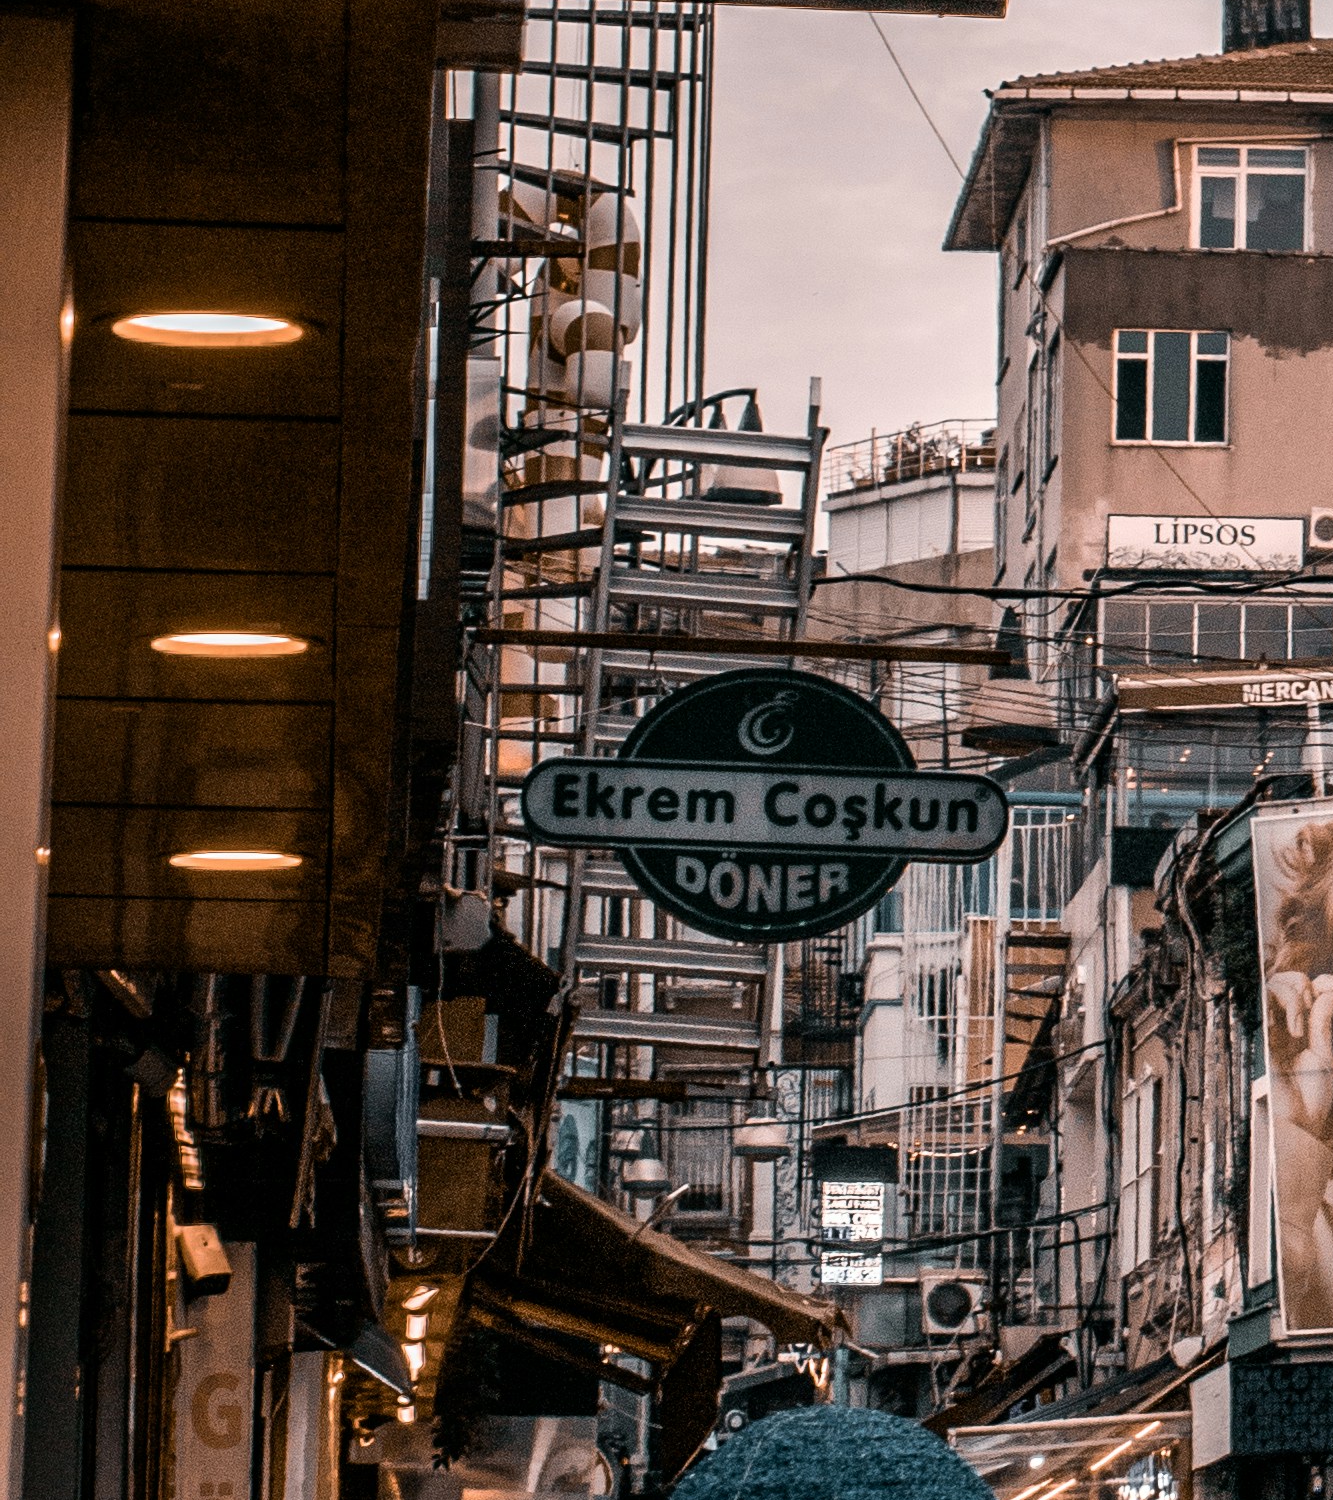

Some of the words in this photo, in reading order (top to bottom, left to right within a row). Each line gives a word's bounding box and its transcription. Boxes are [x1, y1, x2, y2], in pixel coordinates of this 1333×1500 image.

[1153, 516, 1257, 549] LİPSOS
[551, 772, 736, 825] Ekrem
[675, 851, 850, 914] DÖNER
